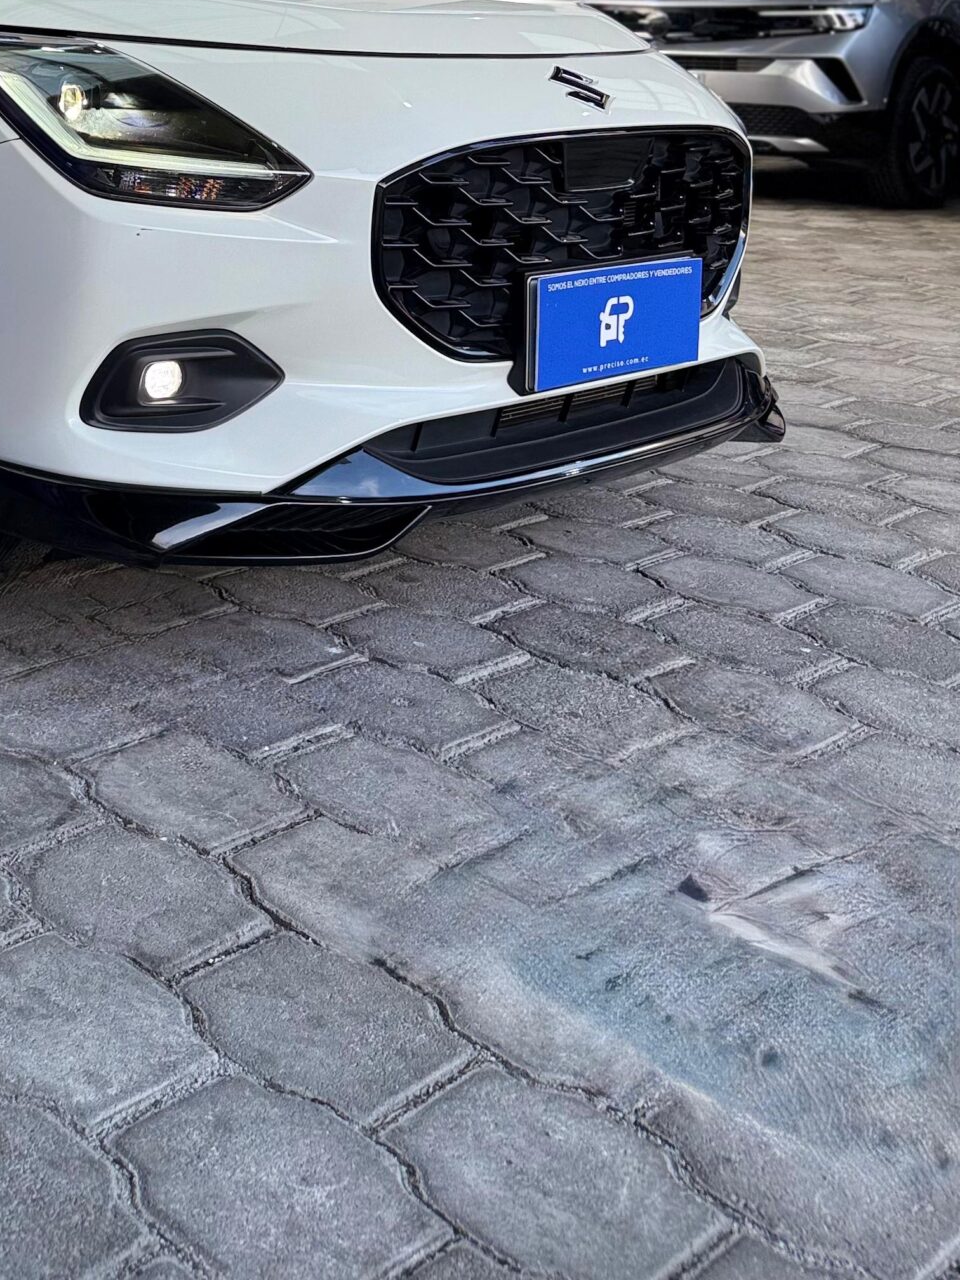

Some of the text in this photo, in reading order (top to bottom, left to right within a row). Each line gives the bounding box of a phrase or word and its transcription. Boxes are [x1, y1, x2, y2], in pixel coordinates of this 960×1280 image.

[547, 266, 693, 292] SOMOS EL NEXO ENTRE COMPRADORES Y VENDEDORES
